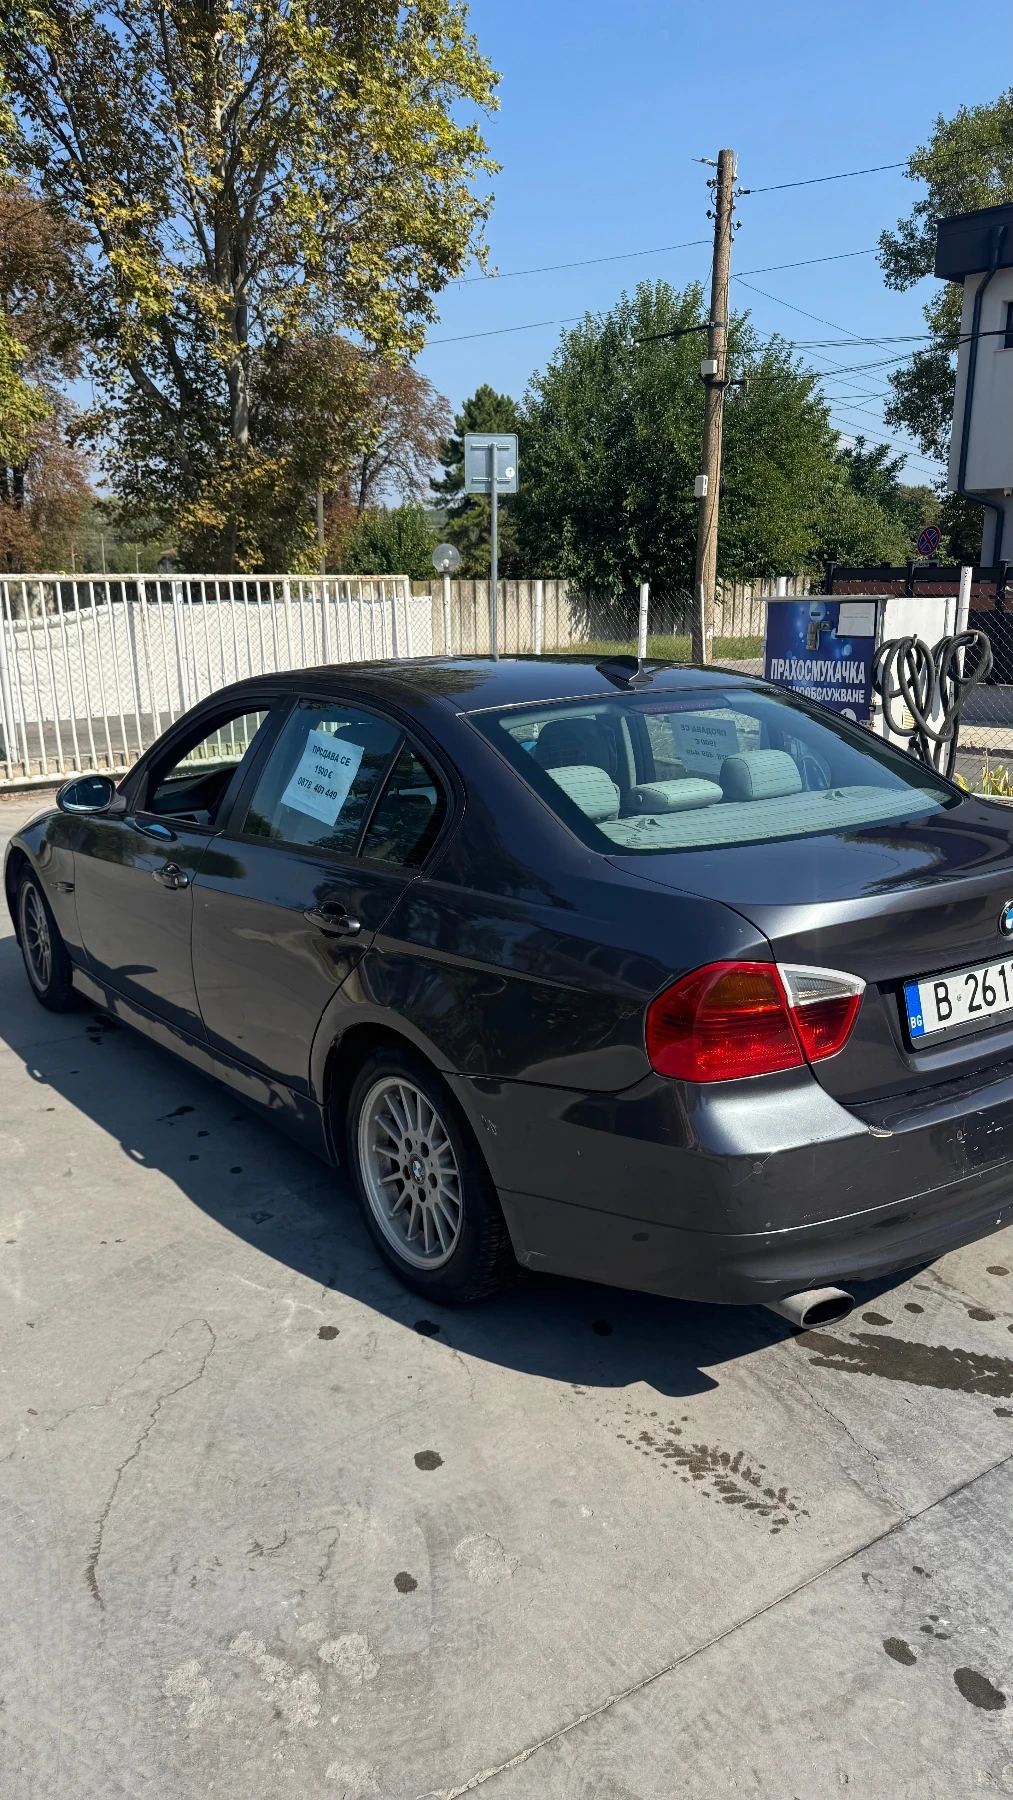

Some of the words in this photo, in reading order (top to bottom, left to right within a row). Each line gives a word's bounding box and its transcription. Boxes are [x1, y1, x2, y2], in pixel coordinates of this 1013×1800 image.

[770, 658, 866, 684] ПРАХОСМУКАЧКА
[312, 745, 339, 763] ПРОДАВА
[340, 756, 352, 766] СЕ
[933, 981, 953, 1022] B
[964, 962, 1013, 1013] 261
[910, 1015, 922, 1028] BG
